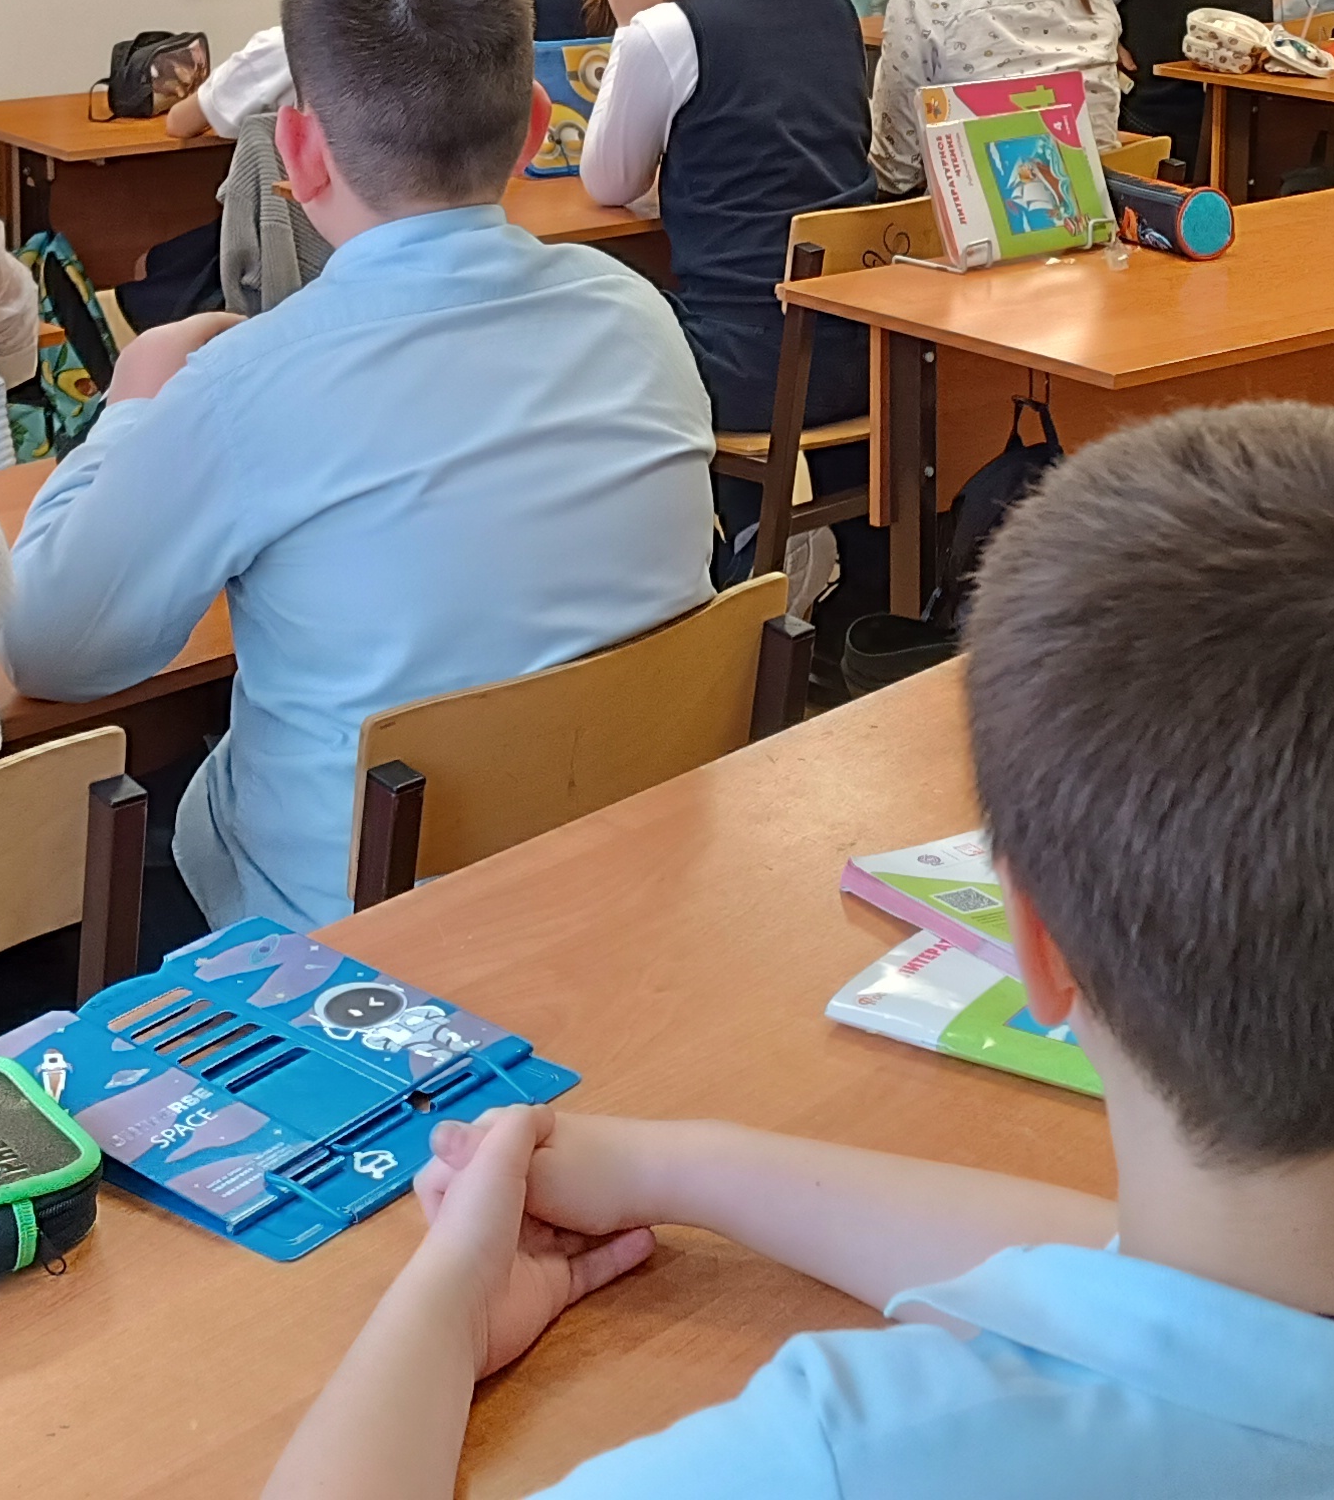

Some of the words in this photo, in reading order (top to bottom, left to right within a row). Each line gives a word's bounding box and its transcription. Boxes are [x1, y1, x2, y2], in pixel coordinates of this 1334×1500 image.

[945, 133, 962, 178] ЧТЕНИЕ
[935, 135, 968, 225] ЛИТЕРАТУРНОЕ
[150, 1108, 219, 1150] SPACE
